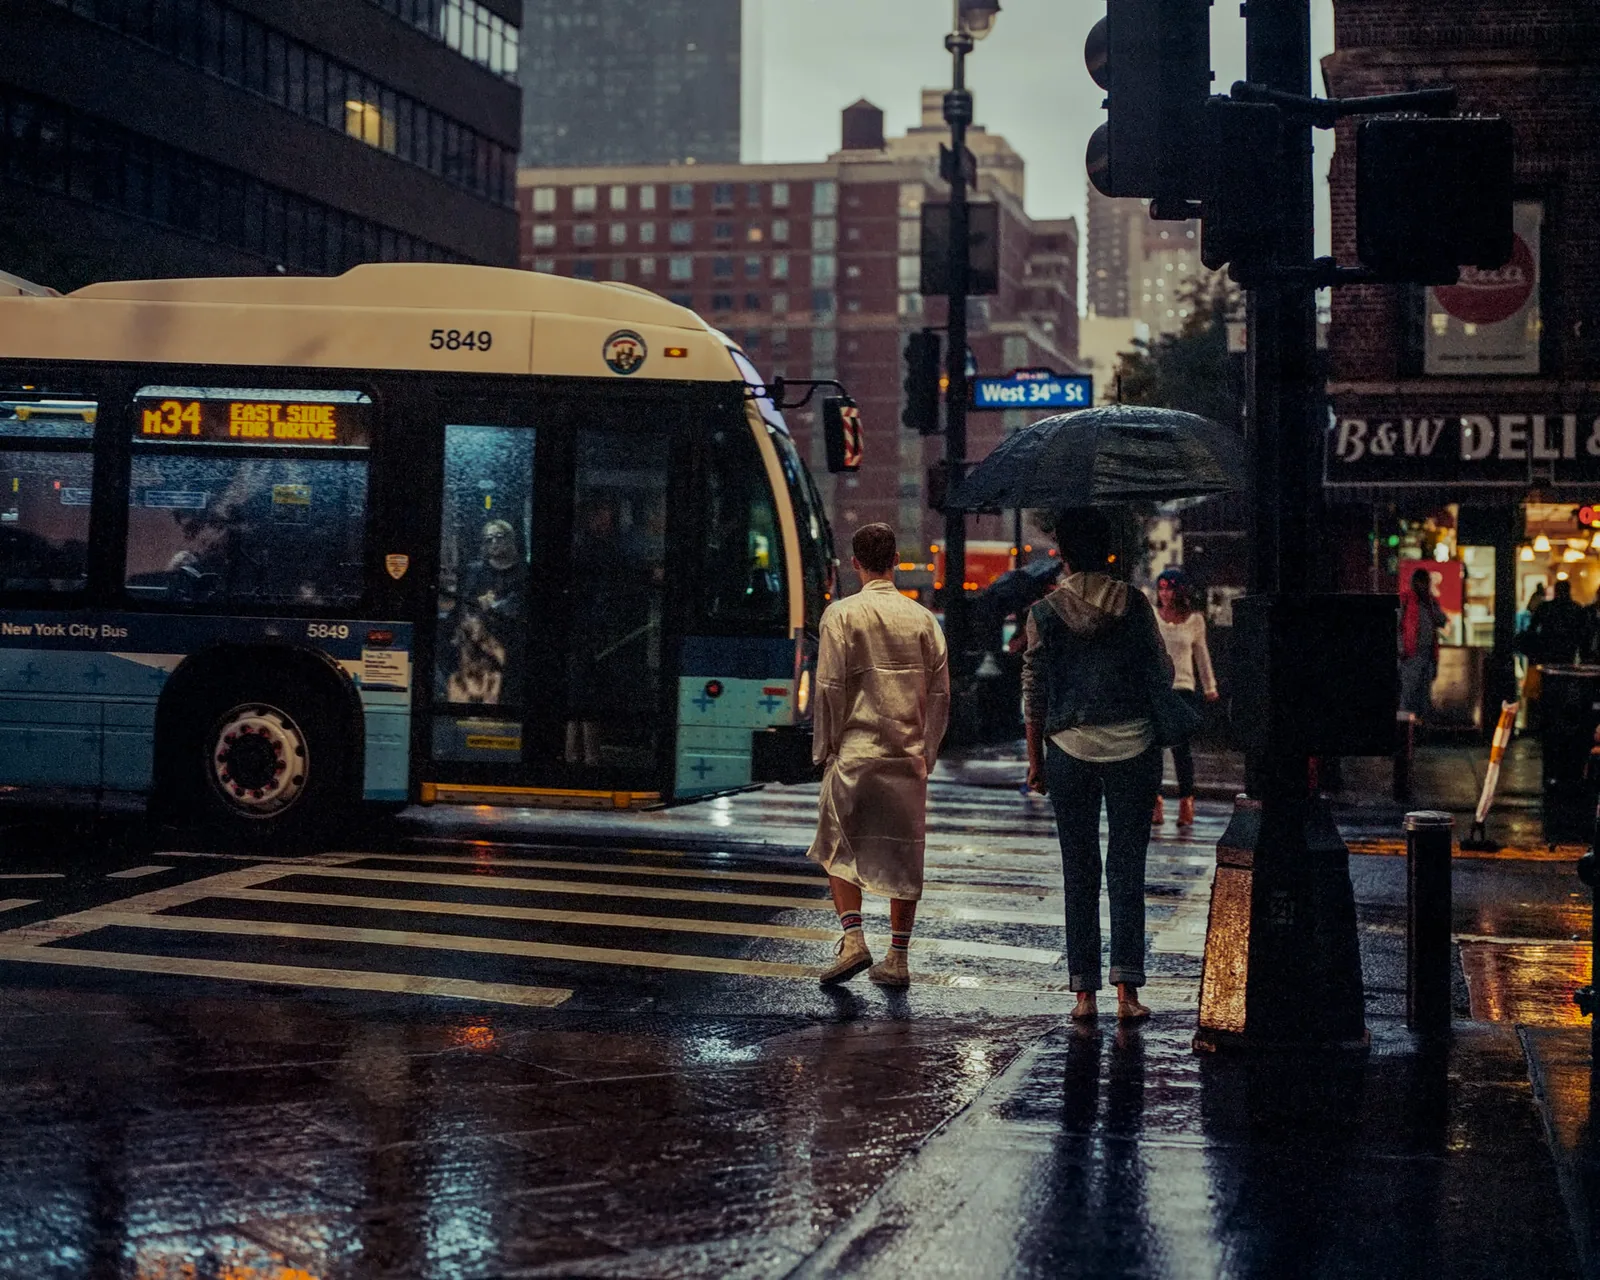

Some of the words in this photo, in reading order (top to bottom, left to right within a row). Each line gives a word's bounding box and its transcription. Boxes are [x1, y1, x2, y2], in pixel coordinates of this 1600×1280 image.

[430, 329, 492, 352] 5849
[981, 383, 1026, 403] West
[1064, 382, 1084, 403] St
[229, 403, 282, 422] EAST
[286, 405, 336, 424] SIDE
[273, 422, 337, 440] DRIVE
[1336, 418, 1445, 463] B&W
[1460, 413, 1576, 461] DELI
[1, 622, 33, 636] New
[35, 623, 66, 637] York
[69, 624, 98, 640] City
[101, 626, 128, 638] Bus
[307, 624, 349, 639] 5849
